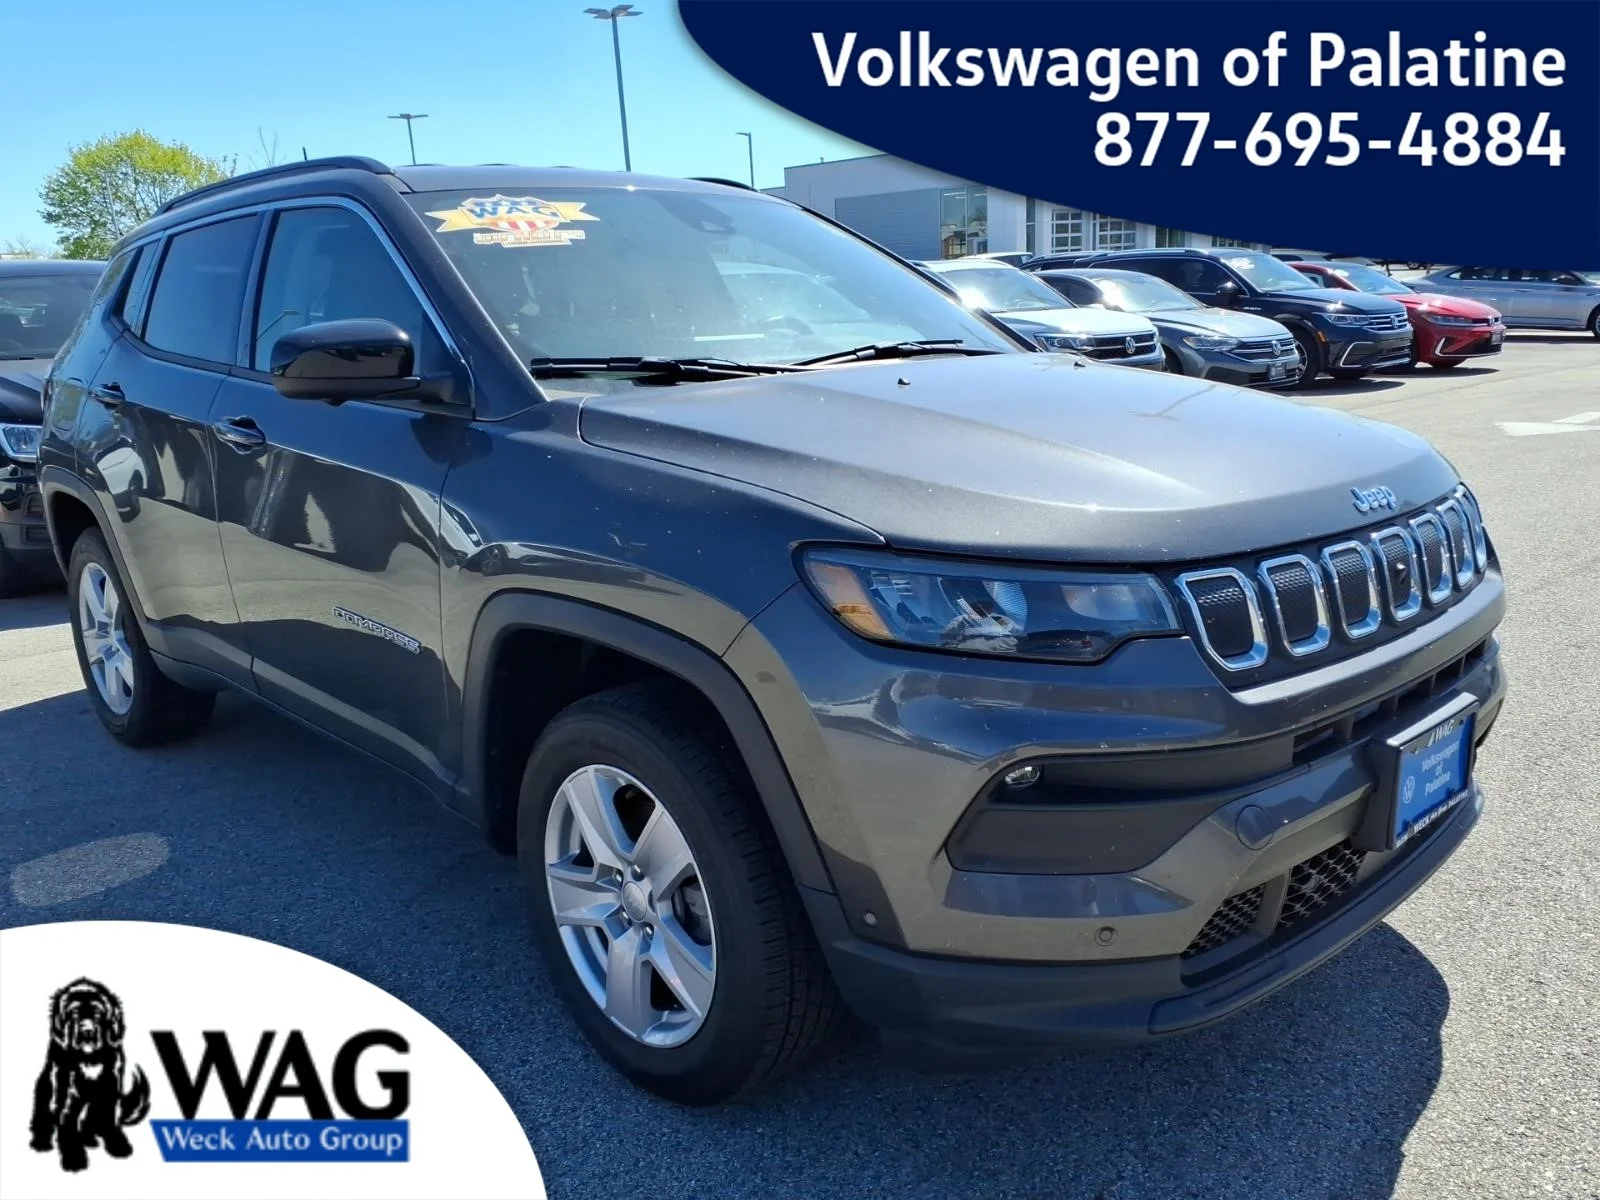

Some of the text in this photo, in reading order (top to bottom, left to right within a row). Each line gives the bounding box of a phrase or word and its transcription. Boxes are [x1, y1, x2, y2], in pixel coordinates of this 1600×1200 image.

[468, 205, 561, 219] WAG
[1351, 486, 1397, 512] Jeep
[331, 606, 421, 654] COMPASS
[1422, 740, 1460, 772] Volkswagen
[1425, 771, 1451, 797] Palatine
